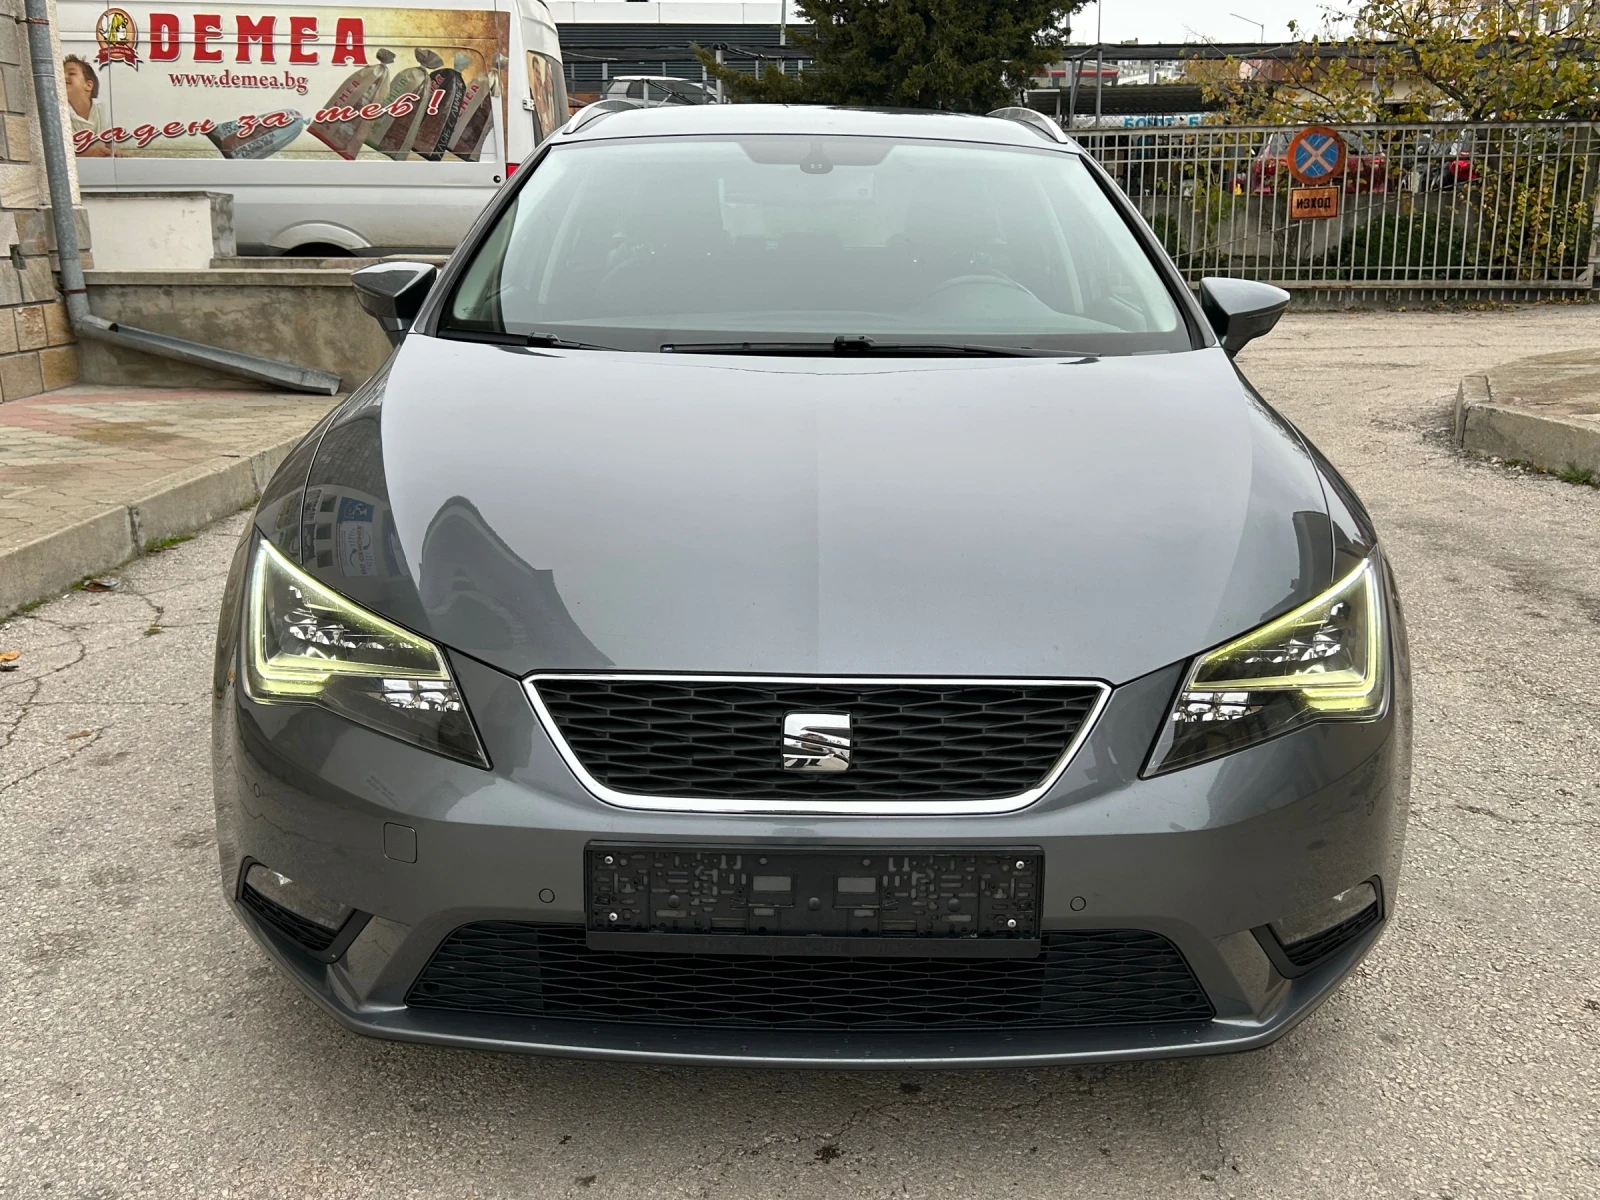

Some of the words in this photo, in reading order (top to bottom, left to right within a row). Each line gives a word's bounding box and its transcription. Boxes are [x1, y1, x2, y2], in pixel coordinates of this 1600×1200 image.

[149, 13, 369, 66] DEMEA
[168, 69, 309, 94] www.demea.bg
[236, 110, 294, 138] за
[1296, 196, 1331, 209] ИЗХОД
